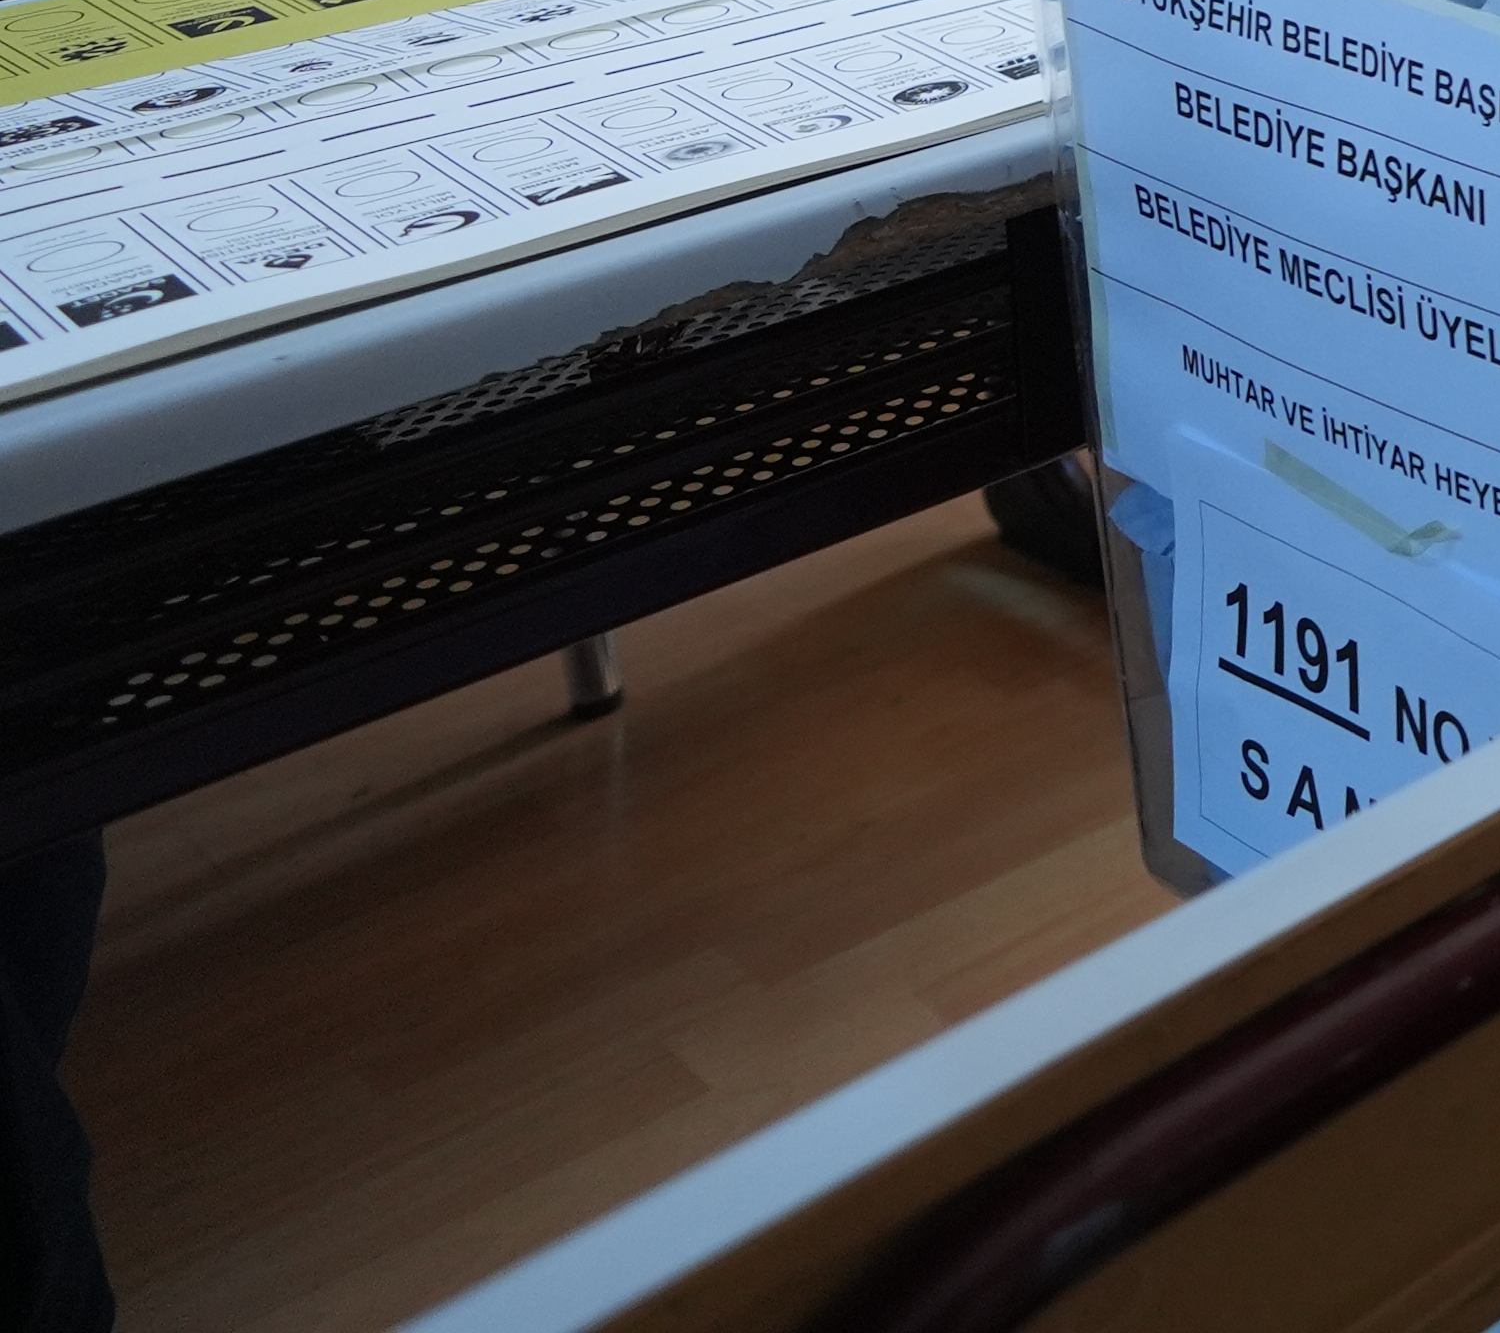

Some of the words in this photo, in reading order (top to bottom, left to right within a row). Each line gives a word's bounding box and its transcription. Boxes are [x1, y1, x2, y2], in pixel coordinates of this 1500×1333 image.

[1282, 20, 1425, 97] BELEDİYE
[1174, 81, 1326, 169] BELEDİYE
[1336, 139, 1487, 227] BAŞKANI
[1134, 183, 1272, 276] BELEDİYE
[1278, 247, 1406, 331] MECLİSİ
[1181, 343, 1278, 421] MUHTAR
[1281, 395, 1315, 437] VE
[1321, 407, 1428, 486] İHTİYAR
[1225, 582, 1361, 715] 1191
[1394, 685, 1497, 765] NO
